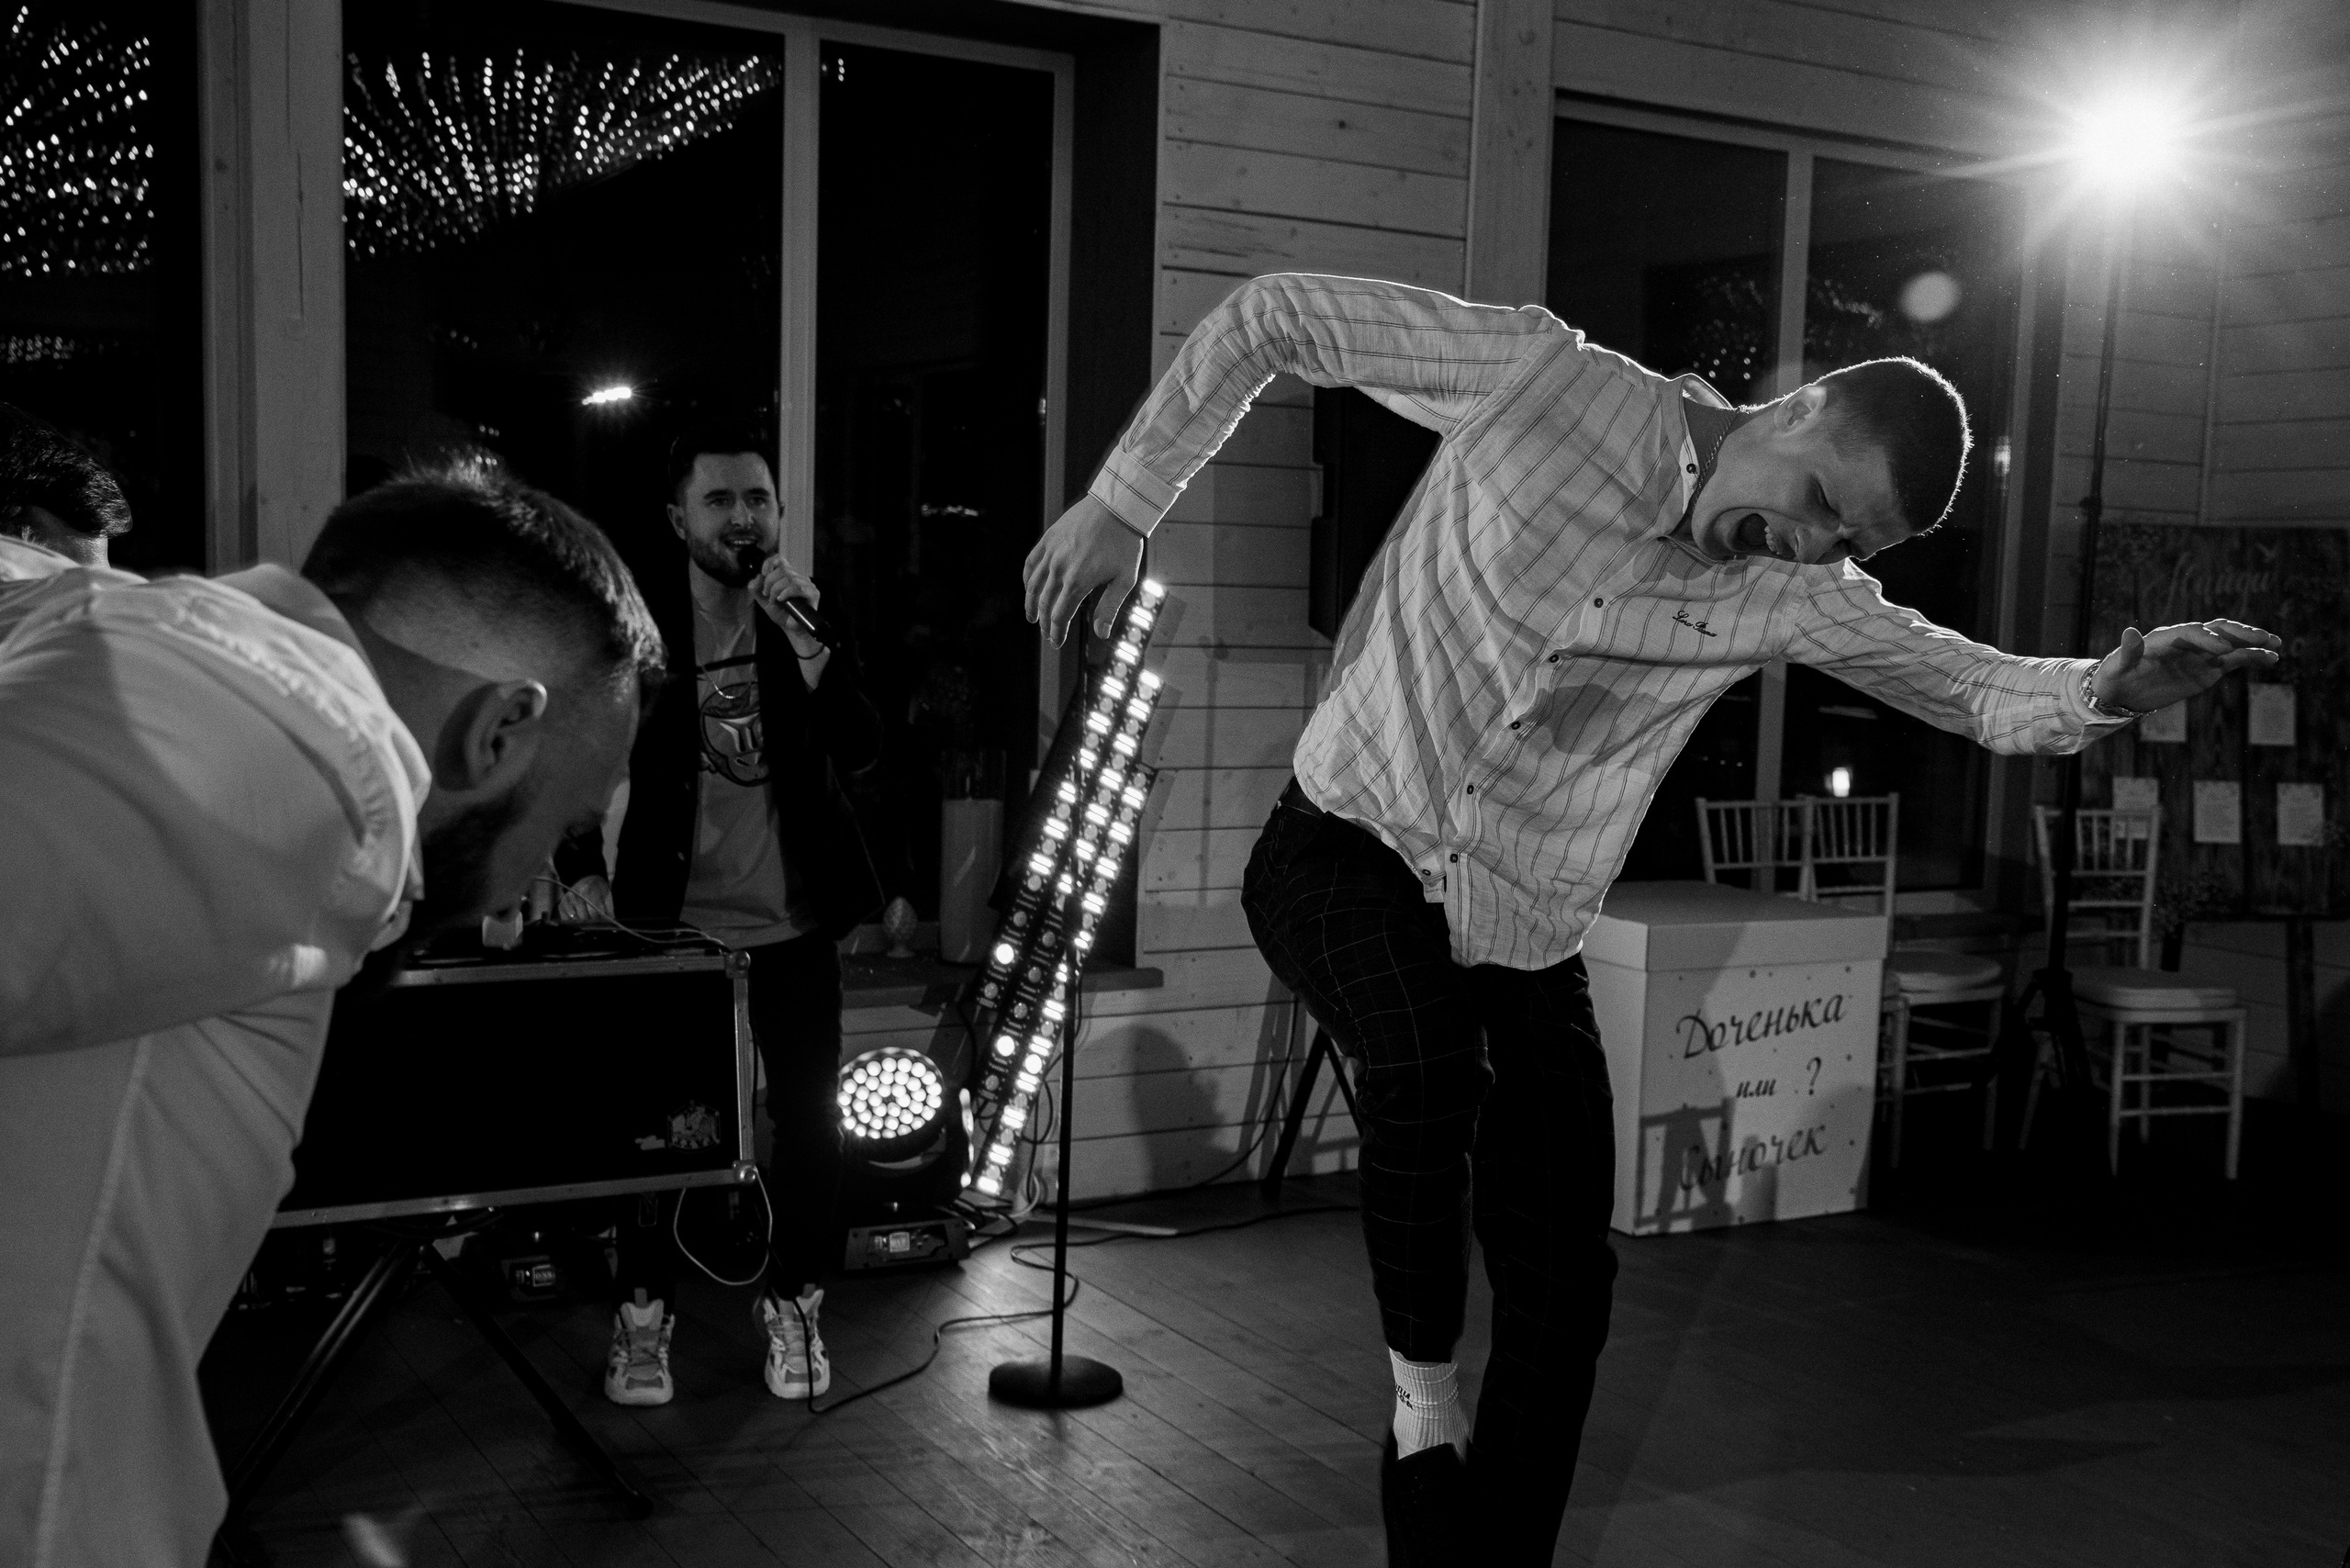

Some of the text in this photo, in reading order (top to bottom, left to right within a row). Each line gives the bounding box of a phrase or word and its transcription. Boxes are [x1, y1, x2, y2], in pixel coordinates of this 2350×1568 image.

[1673, 610, 1693, 626] Loro
[1675, 994, 1846, 1058] Доченька
[1736, 1057, 1822, 1098] или ?
[1680, 1124, 1827, 1193] Сыночек
